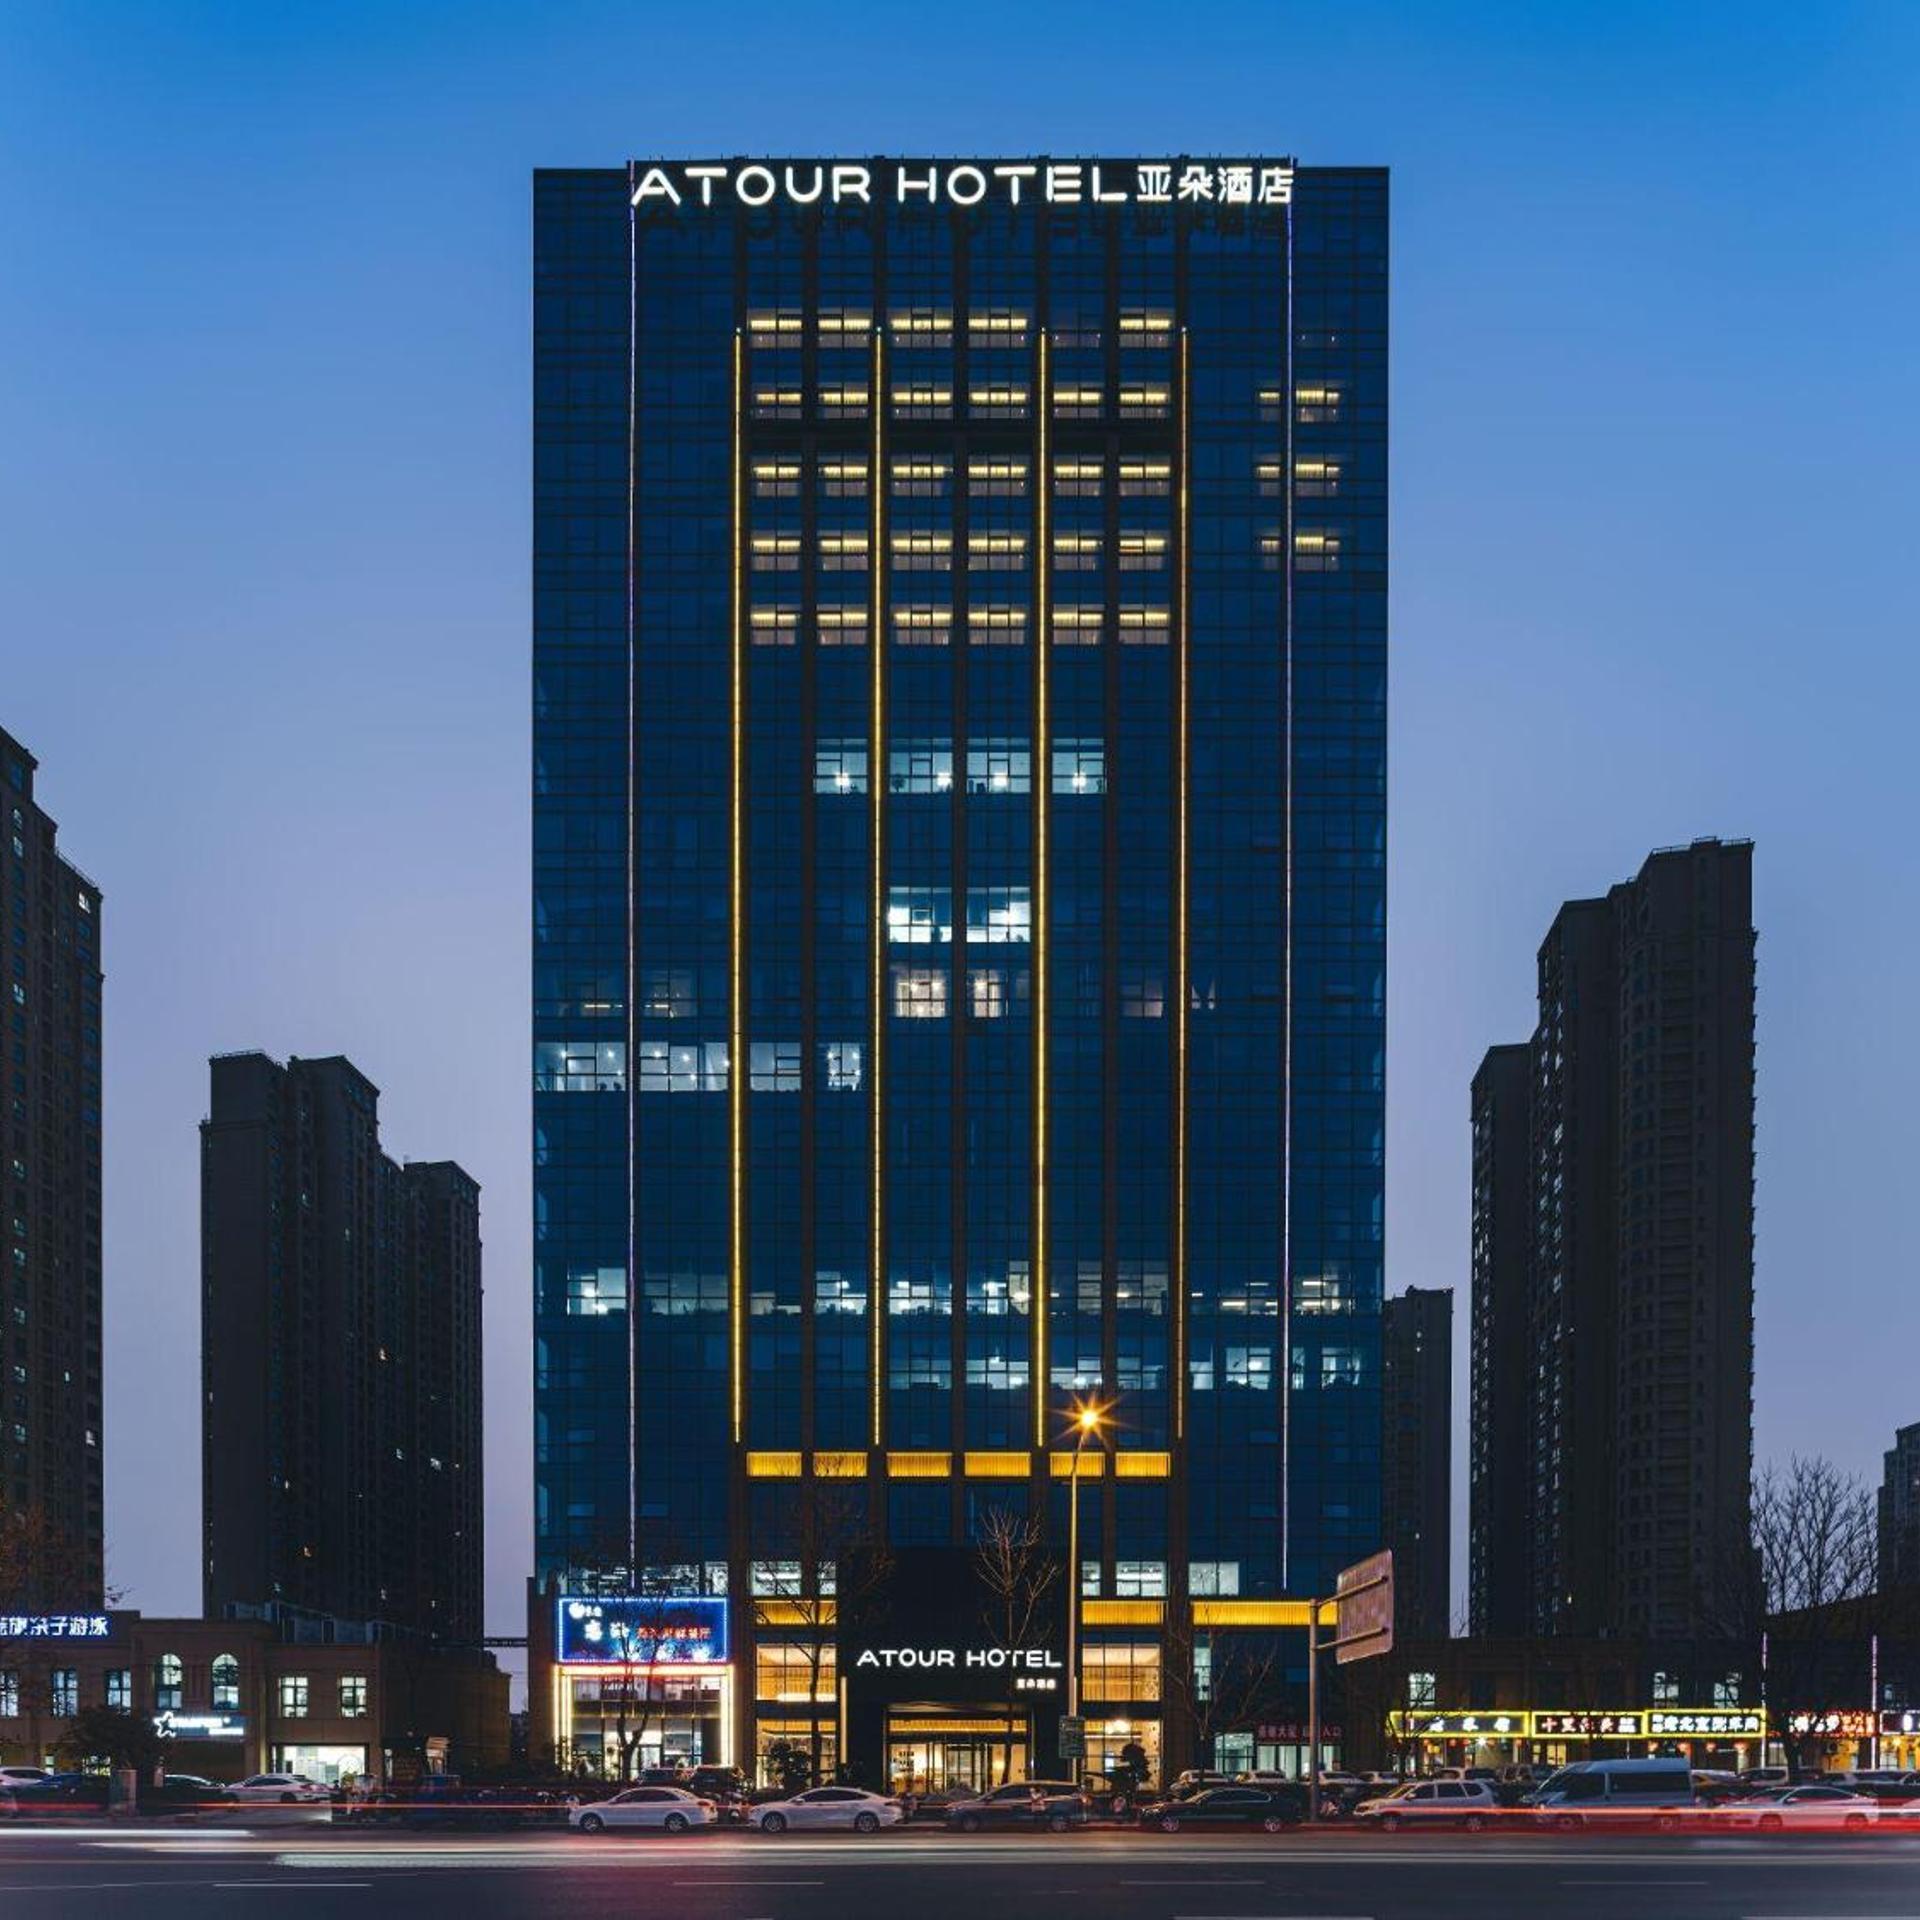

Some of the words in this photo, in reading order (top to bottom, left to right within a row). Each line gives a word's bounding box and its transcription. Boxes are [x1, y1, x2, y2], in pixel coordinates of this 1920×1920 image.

[631, 165, 871, 205] ATOUR
[897, 165, 1128, 205] HOTEL
[1136, 165, 1293, 205] 亚朵酒店
[857, 1649, 955, 1667] ATOUR
[966, 1648, 1062, 1667] HOTEL
